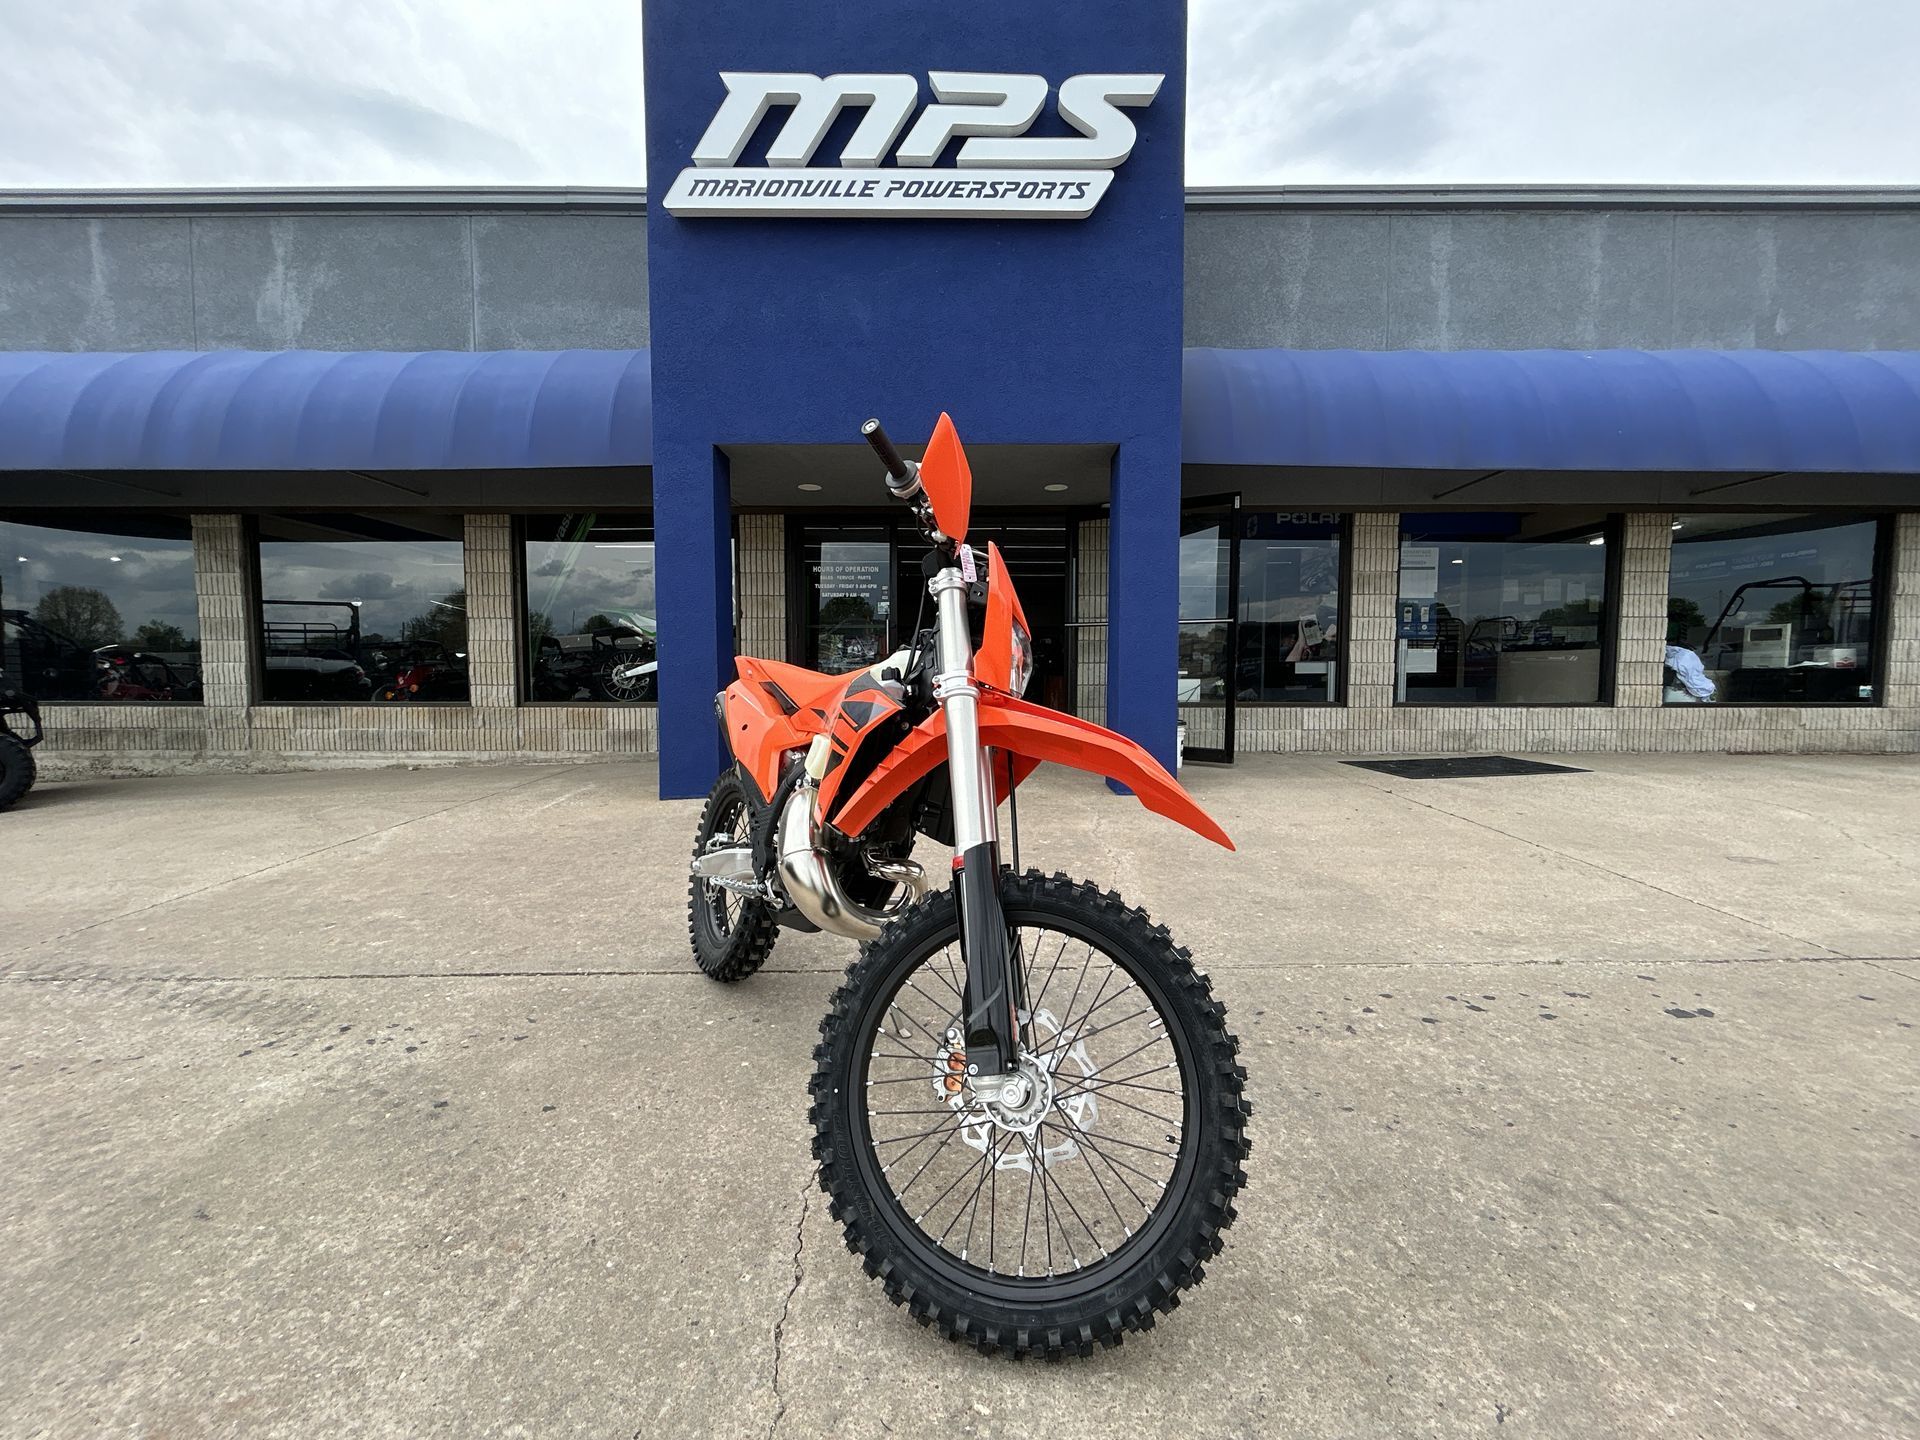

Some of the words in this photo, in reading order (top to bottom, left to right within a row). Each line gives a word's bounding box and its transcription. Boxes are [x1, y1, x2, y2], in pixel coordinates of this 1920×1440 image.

[691, 70, 1165, 168] MPS
[688, 178, 881, 199] MARIONVILLE
[884, 179, 1091, 200] POWERSPORTS
